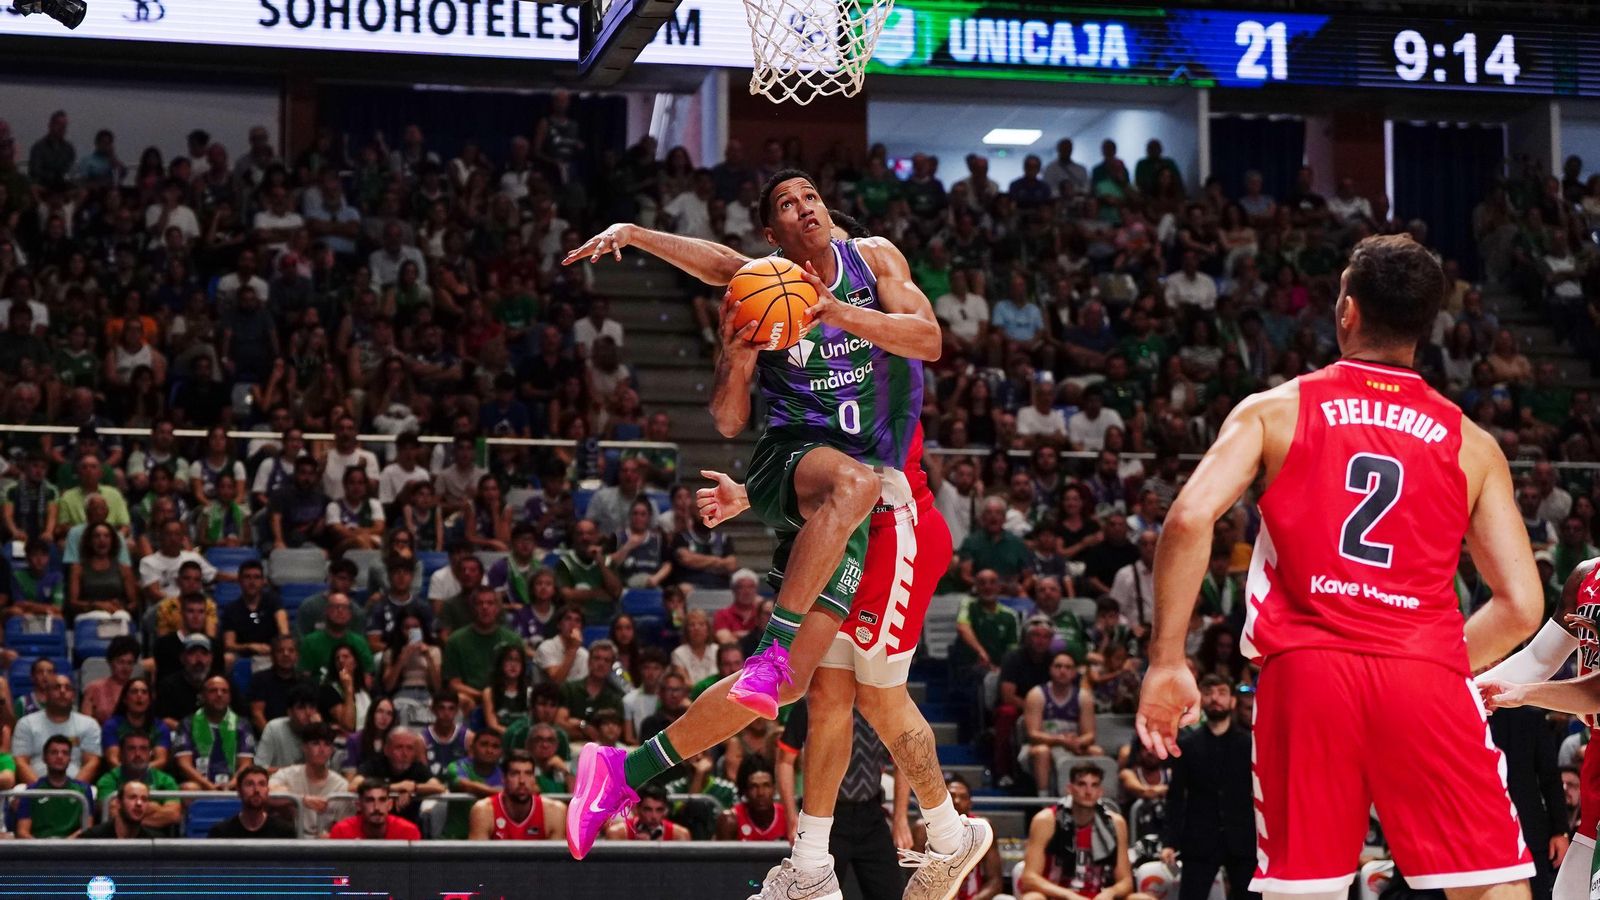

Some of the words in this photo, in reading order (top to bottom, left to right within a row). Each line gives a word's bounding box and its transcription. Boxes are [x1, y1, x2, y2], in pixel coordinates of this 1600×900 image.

[948, 18, 1129, 67] UNICAJA
[1234, 20, 1289, 80] 21
[1393, 30, 1520, 85] 9:14
[838, 400, 861, 435] 0
[1320, 398, 1448, 444] FJELLERUP
[1338, 451, 1404, 569] 2
[1310, 575, 1360, 597] Kave
[1363, 581, 1420, 609] Home
